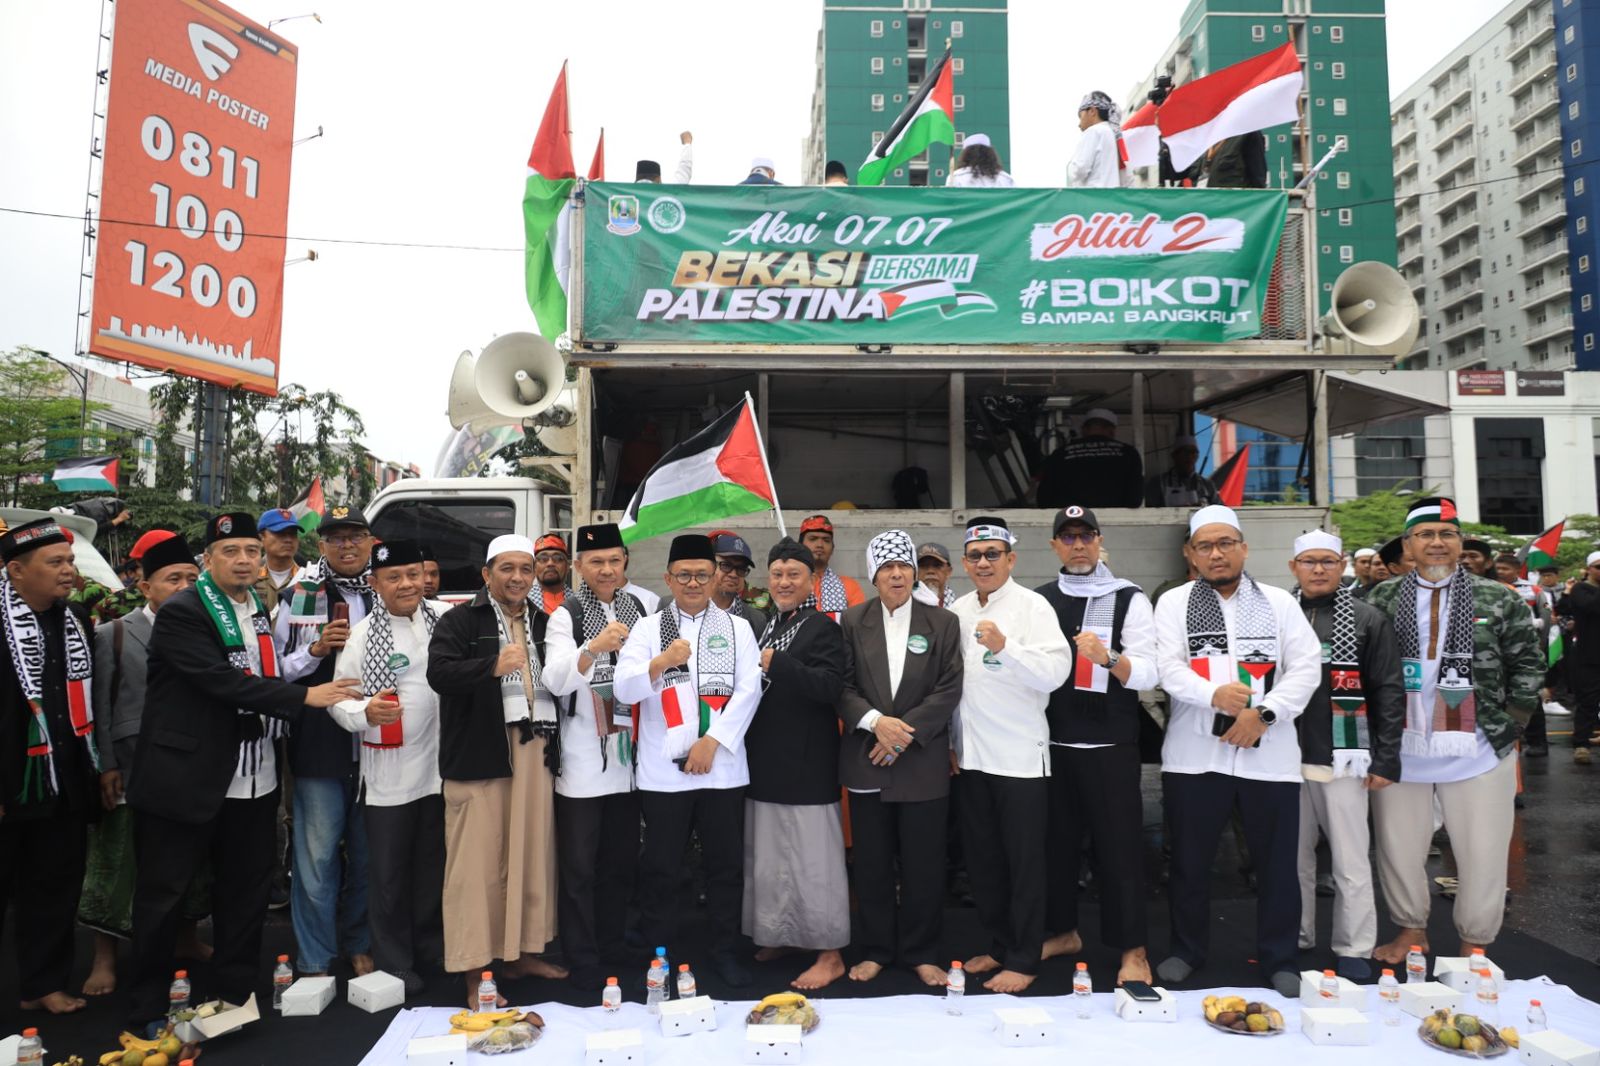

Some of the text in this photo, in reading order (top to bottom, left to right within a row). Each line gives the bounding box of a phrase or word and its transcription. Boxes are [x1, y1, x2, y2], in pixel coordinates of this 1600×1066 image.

[145, 58, 269, 131] MEDIA POSTER
[141, 114, 259, 199] 0811
[150, 182, 243, 252] 100
[722, 211, 953, 247] Aksi 07.07
[1042, 214, 1233, 259] Jilid 2
[124, 240, 257, 318] 1200
[672, 251, 971, 287] BEKASI BERSAMA
[636, 288, 886, 320] PALESTINA
[1020, 276, 1249, 309] #BOIKOT
[1021, 309, 1251, 325] SAMPAI BANGKRUT
